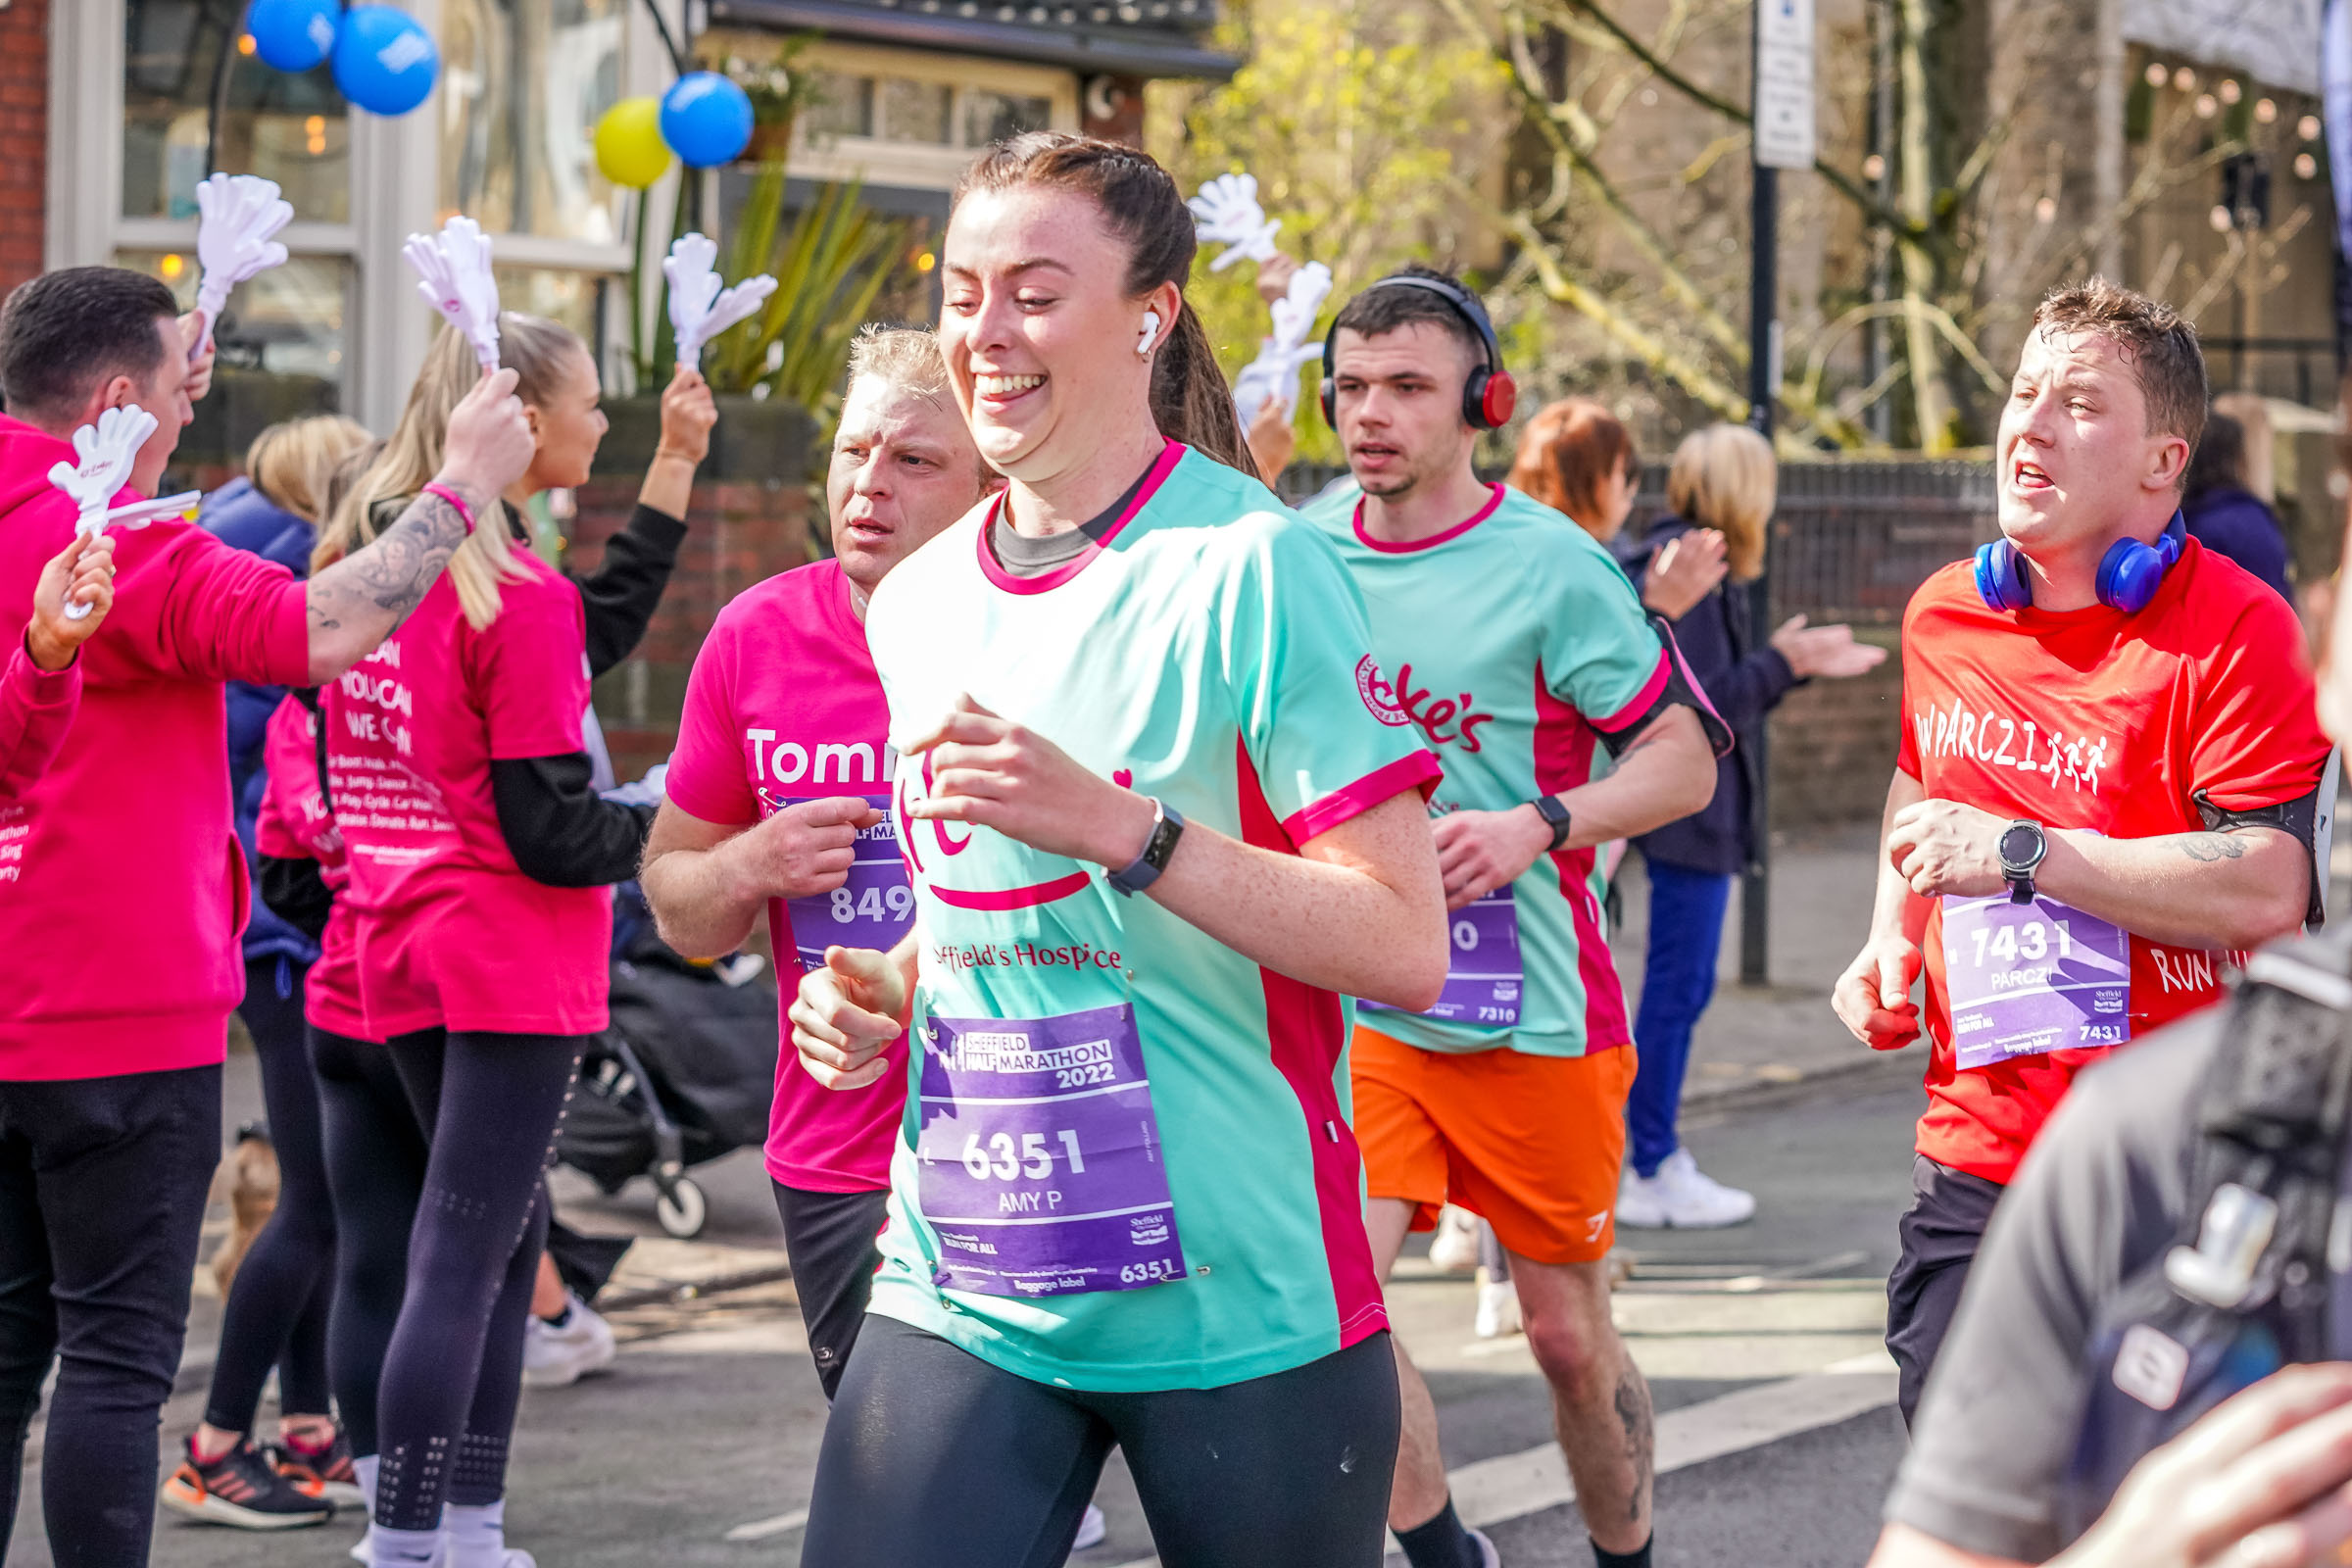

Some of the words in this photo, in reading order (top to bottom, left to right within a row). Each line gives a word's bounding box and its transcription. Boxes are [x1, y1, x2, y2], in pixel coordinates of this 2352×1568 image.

[1014, 943, 1121, 971] Hospice
[1971, 919, 2071, 968] 7431
[1991, 967, 2052, 991] PARCZI
[2150, 948, 2214, 994] RUN
[1478, 1006, 1516, 1023] 7310
[2079, 1025, 2121, 1042] 7431
[998, 1043, 1109, 1071] MARATHON
[1055, 1061, 1116, 1089] 2022
[961, 1129, 1085, 1182] 6351
[999, 1193, 1042, 1212] AMY
[1047, 1191, 1062, 1210] P
[1058, 1275, 1086, 1288] label
[1120, 1258, 1175, 1284] 6351
